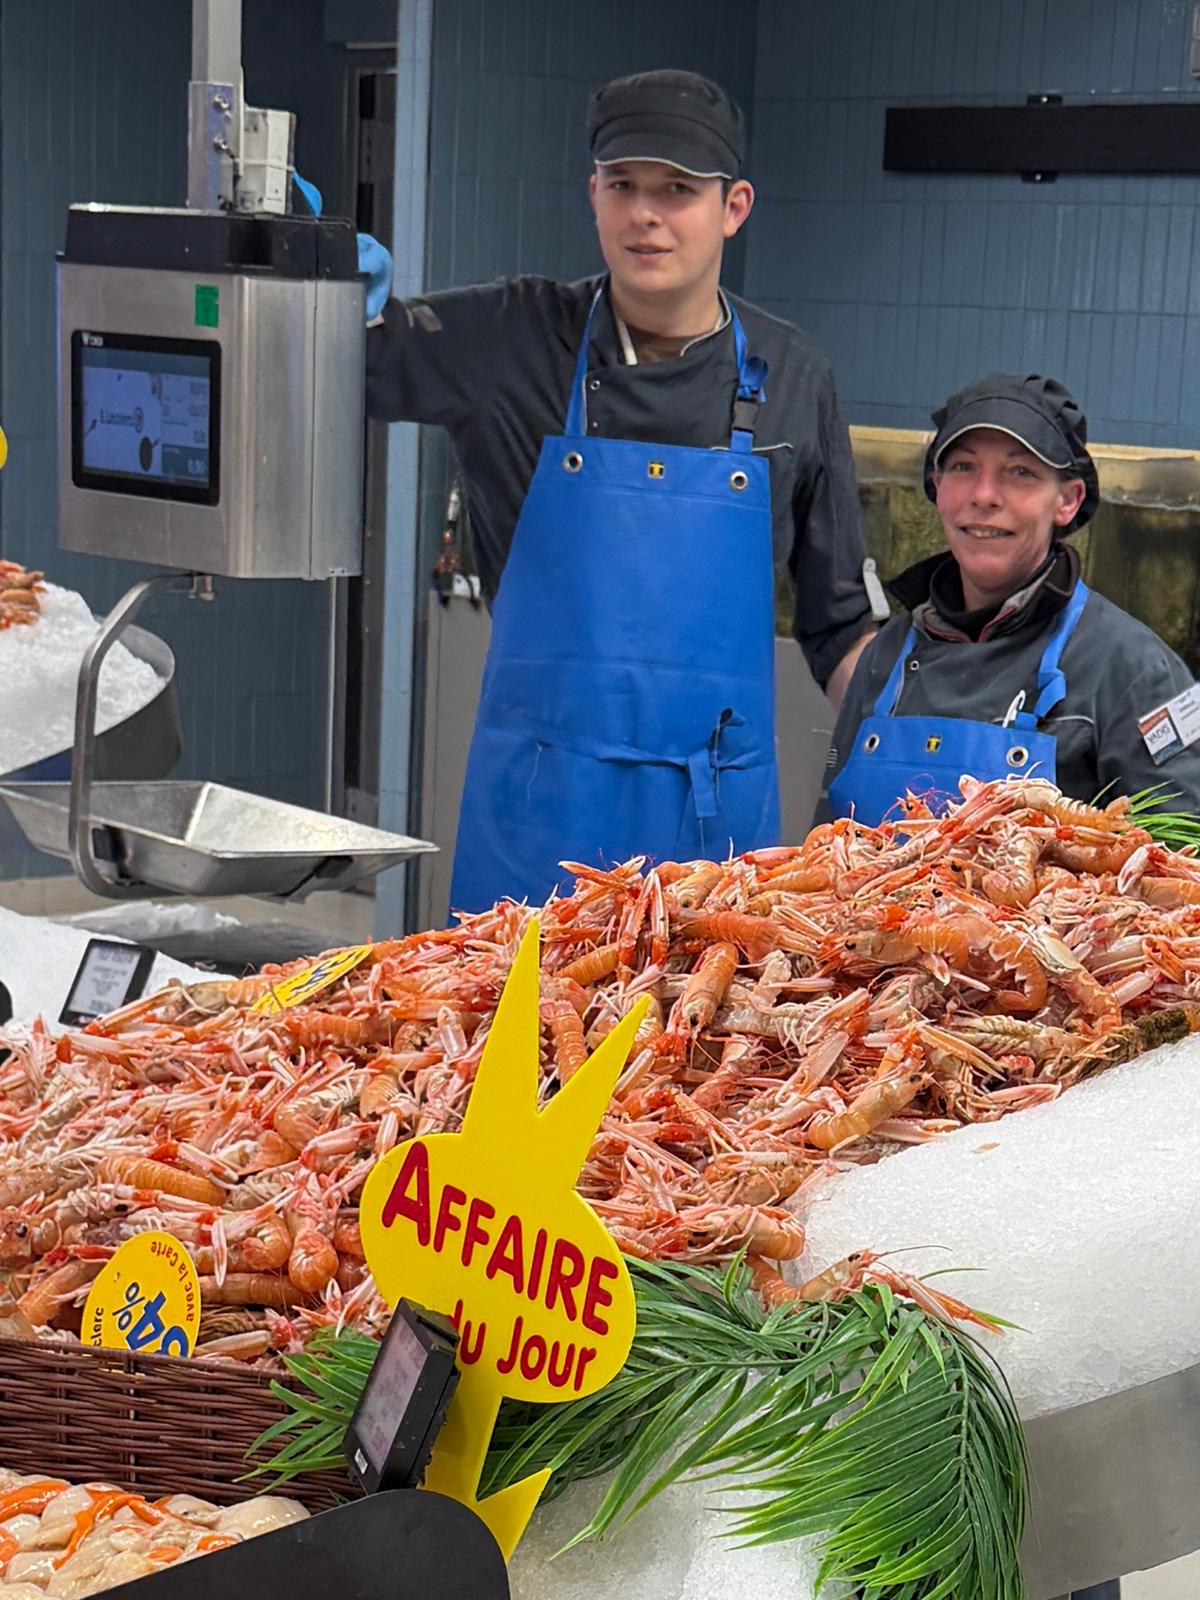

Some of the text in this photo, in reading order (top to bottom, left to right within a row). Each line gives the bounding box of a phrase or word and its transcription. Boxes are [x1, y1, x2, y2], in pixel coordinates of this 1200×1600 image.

[381, 1141, 619, 1336] AFFAIRE
[150, 1241, 195, 1322] avec la Carte
[496, 1316, 597, 1392] Jour
